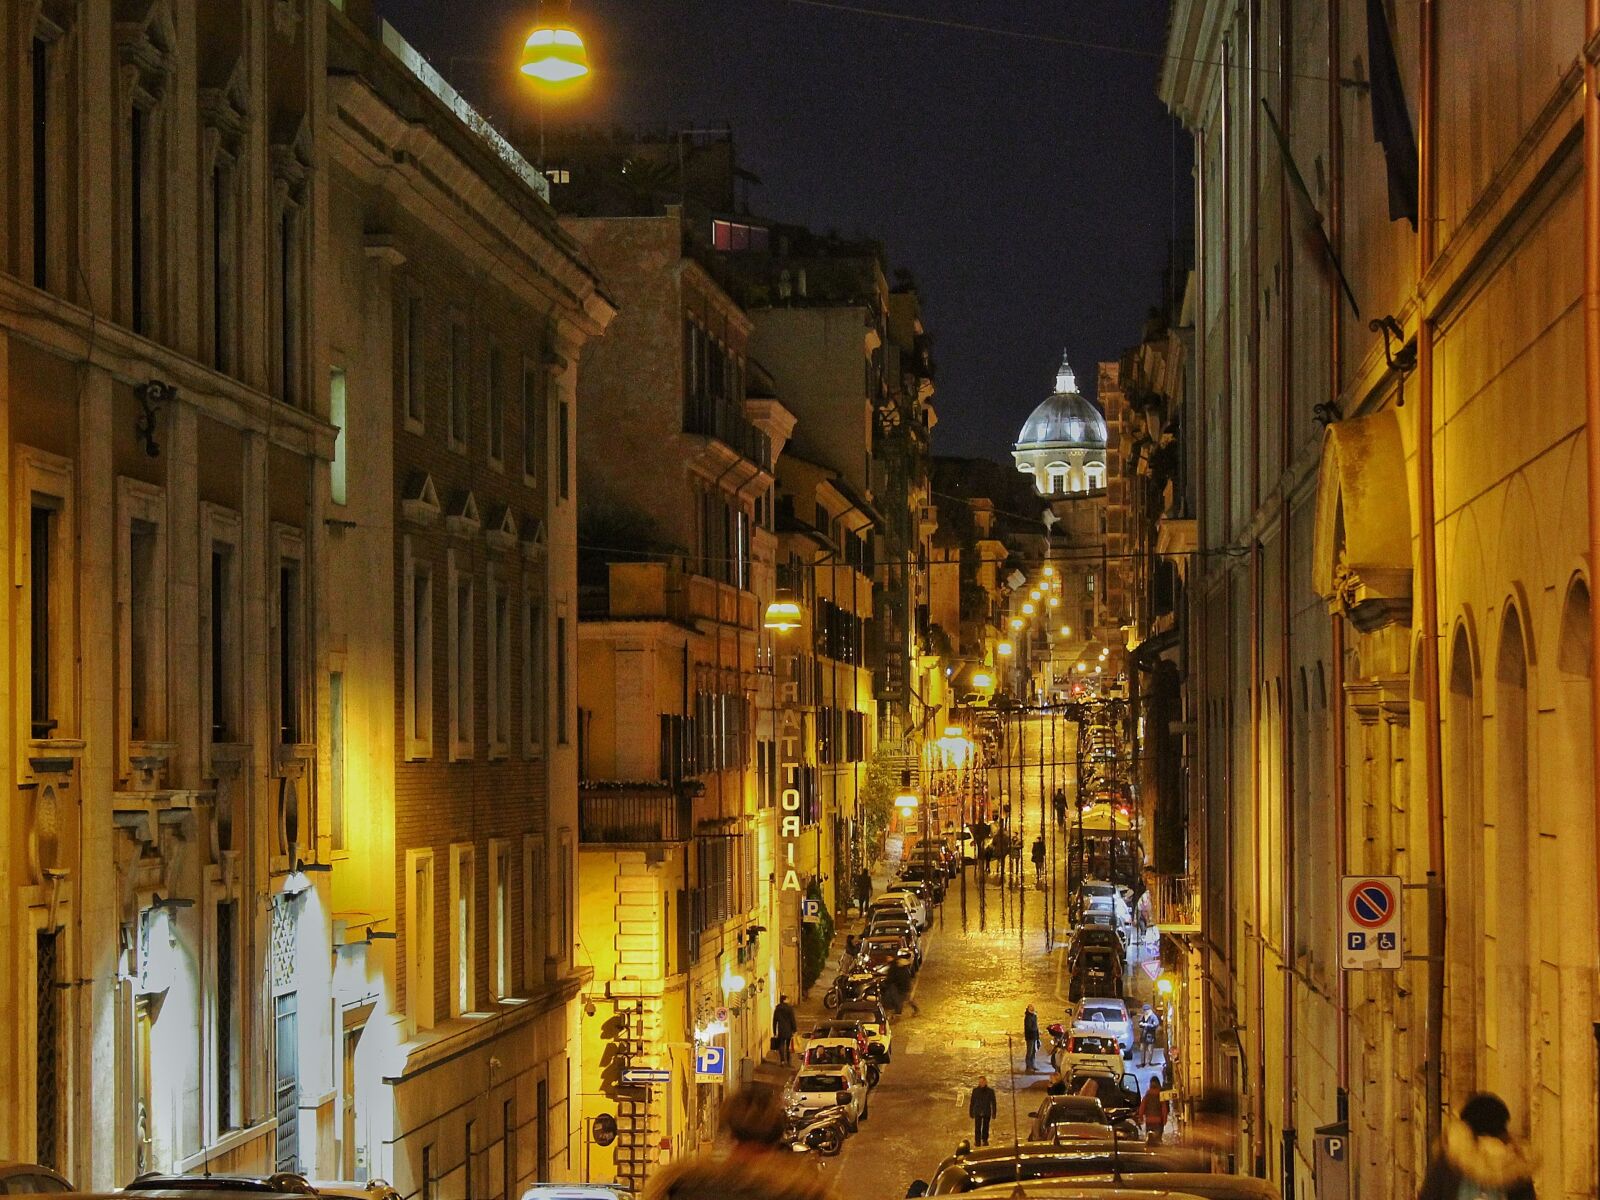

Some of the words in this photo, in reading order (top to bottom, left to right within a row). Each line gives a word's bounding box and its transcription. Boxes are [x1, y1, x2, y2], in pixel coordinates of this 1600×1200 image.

[807, 902, 818, 916] P
[1351, 935, 1361, 947] P
[701, 1049, 720, 1072] P
[1329, 1139, 1341, 1156] P
